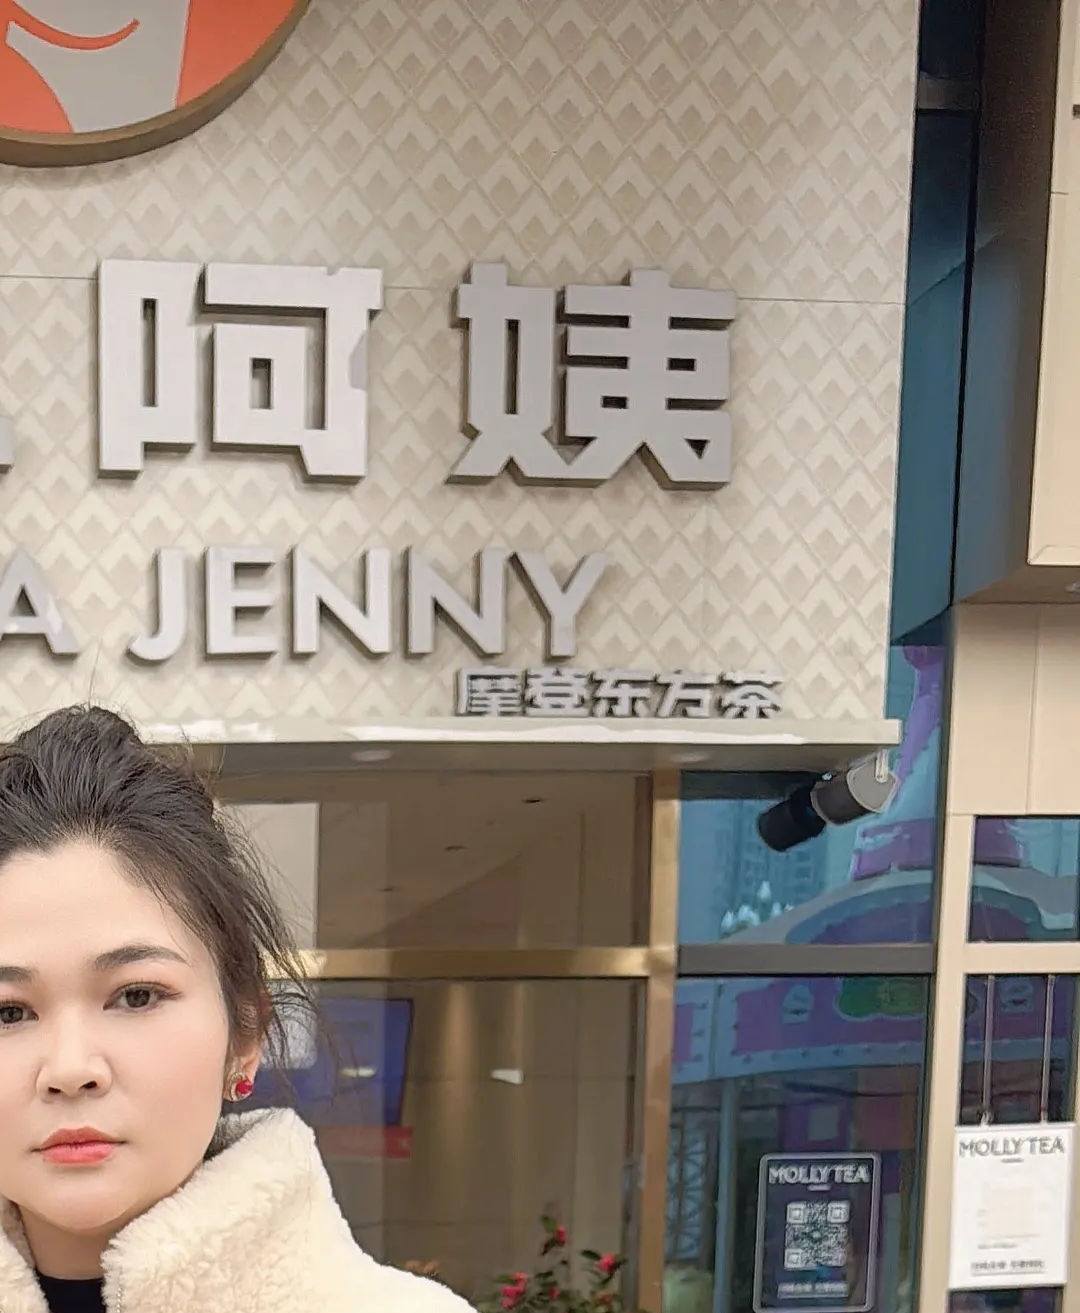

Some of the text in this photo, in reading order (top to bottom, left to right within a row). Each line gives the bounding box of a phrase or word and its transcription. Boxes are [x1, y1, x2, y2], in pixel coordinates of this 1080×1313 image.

[125, 545, 610, 661] JENNY
[454, 667, 785, 718] 摩登东方茶
[958, 1136, 1065, 1157] MOLLY TEA
[768, 1163, 871, 1184] MOLLY TEA
